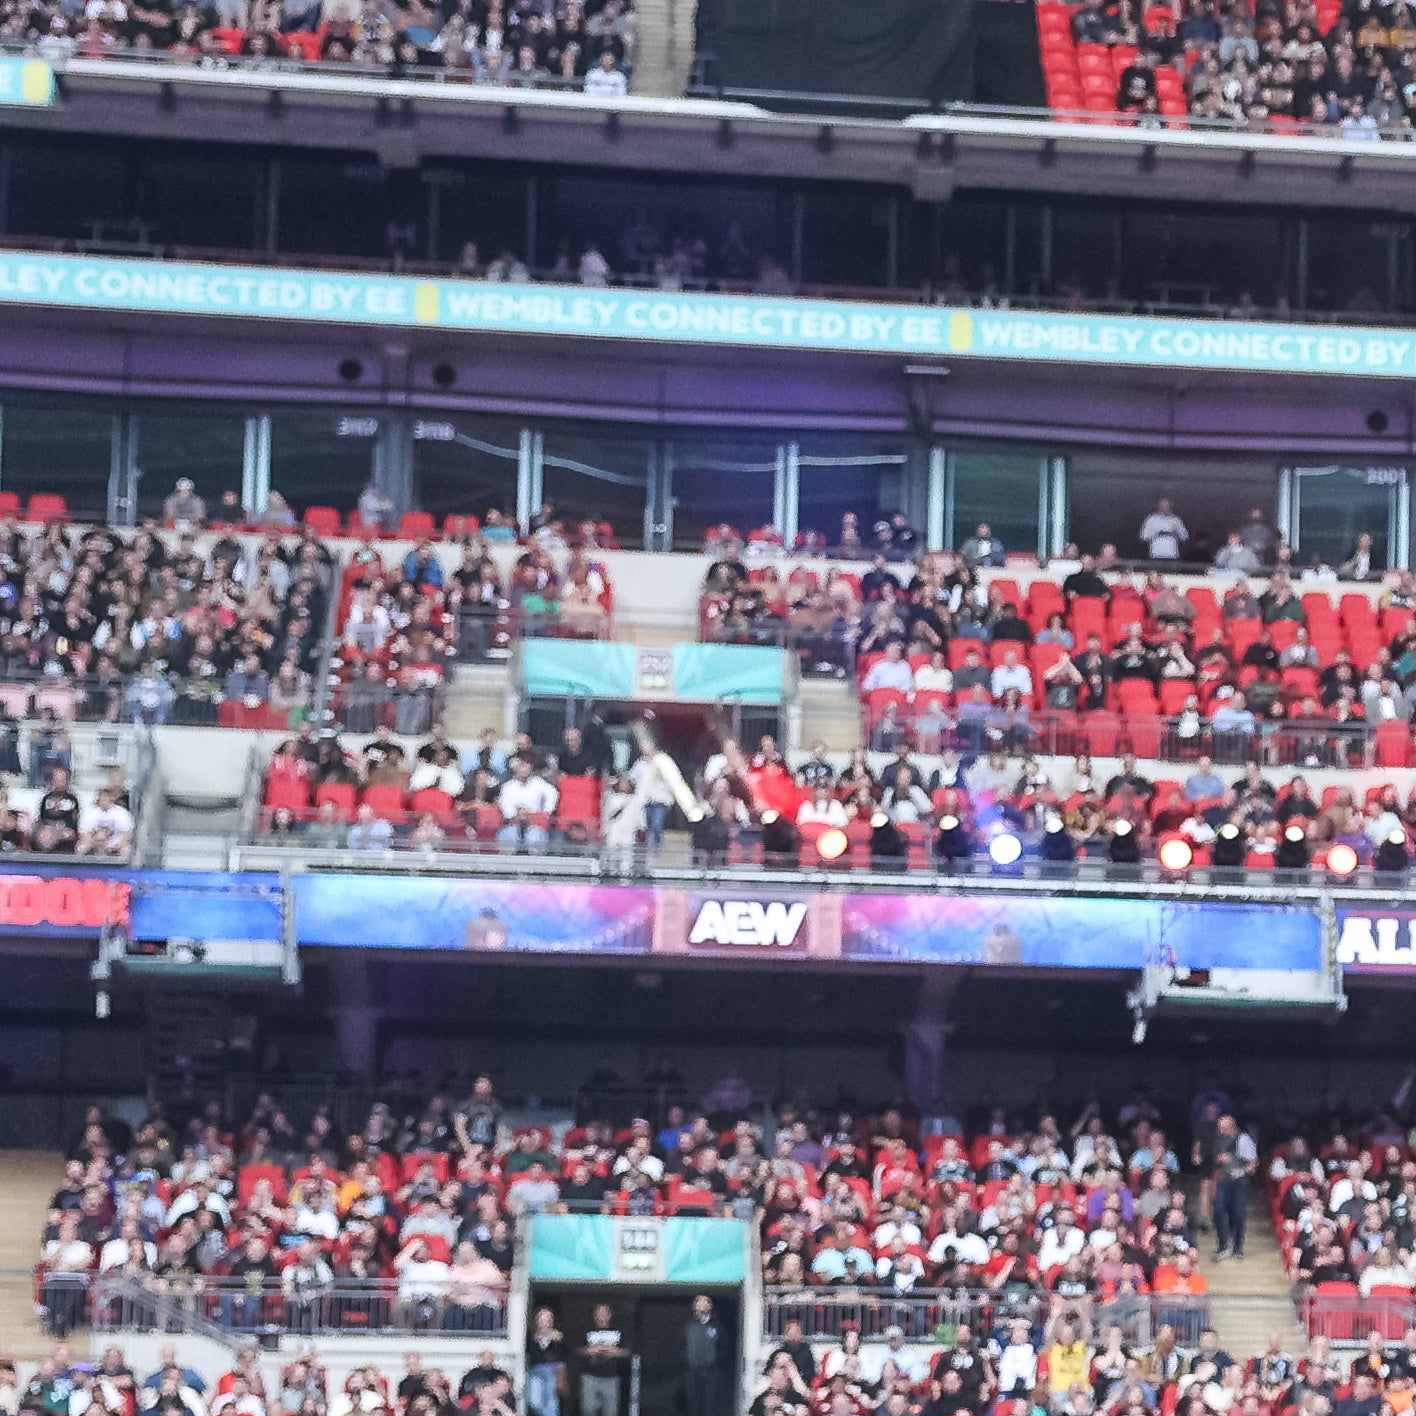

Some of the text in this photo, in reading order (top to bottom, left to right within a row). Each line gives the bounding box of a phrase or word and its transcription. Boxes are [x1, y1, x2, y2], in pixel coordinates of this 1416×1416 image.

[76, 270, 305, 308] CONNECTED
[312, 284, 357, 310] BY
[366, 287, 403, 315] EE
[450, 292, 939, 344] WEMBLEY CONNECTED BY EE
[982, 321, 1142, 353] WEMBLEY
[1151, 329, 1361, 364] CONNECTED
[1366, 340, 1409, 366] BY
[0, 875, 131, 926] DON
[689, 900, 807, 946] AEW
